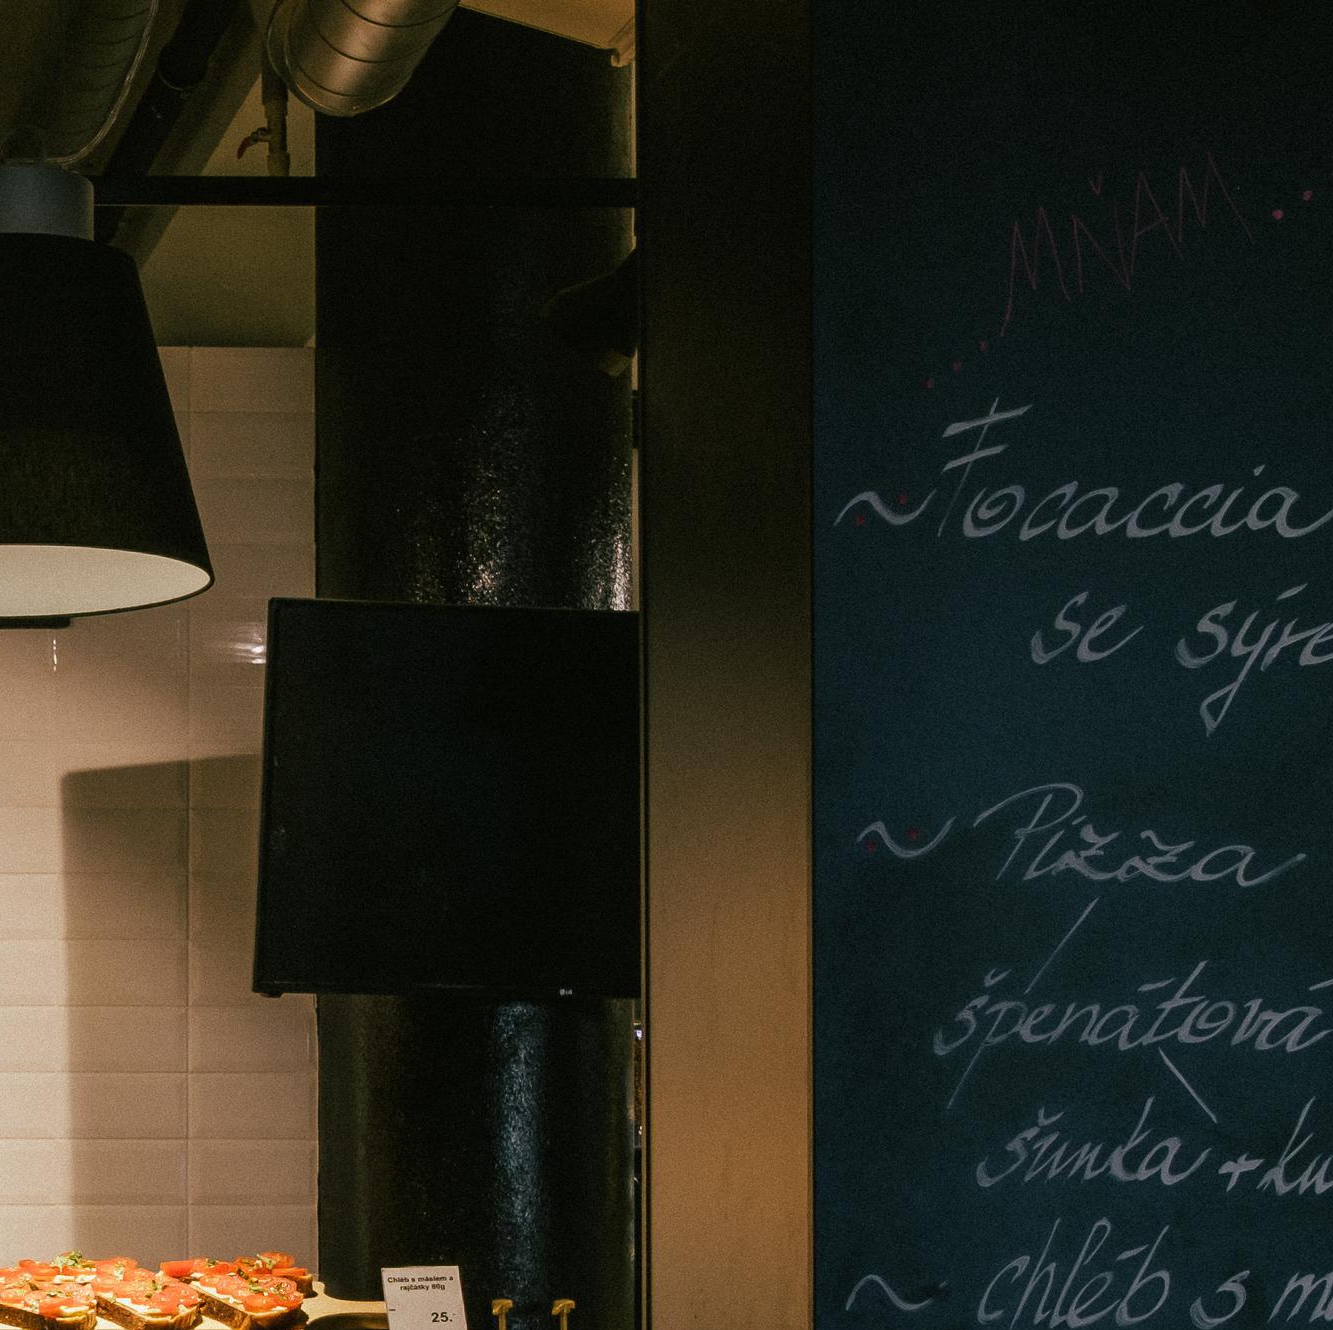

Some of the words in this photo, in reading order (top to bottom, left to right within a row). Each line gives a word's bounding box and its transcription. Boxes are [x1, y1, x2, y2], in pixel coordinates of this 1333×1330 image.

[936, 396, 1333, 541] Focaccia
[1031, 590, 1144, 665] se
[1191, 1269, 1251, 1330] s
